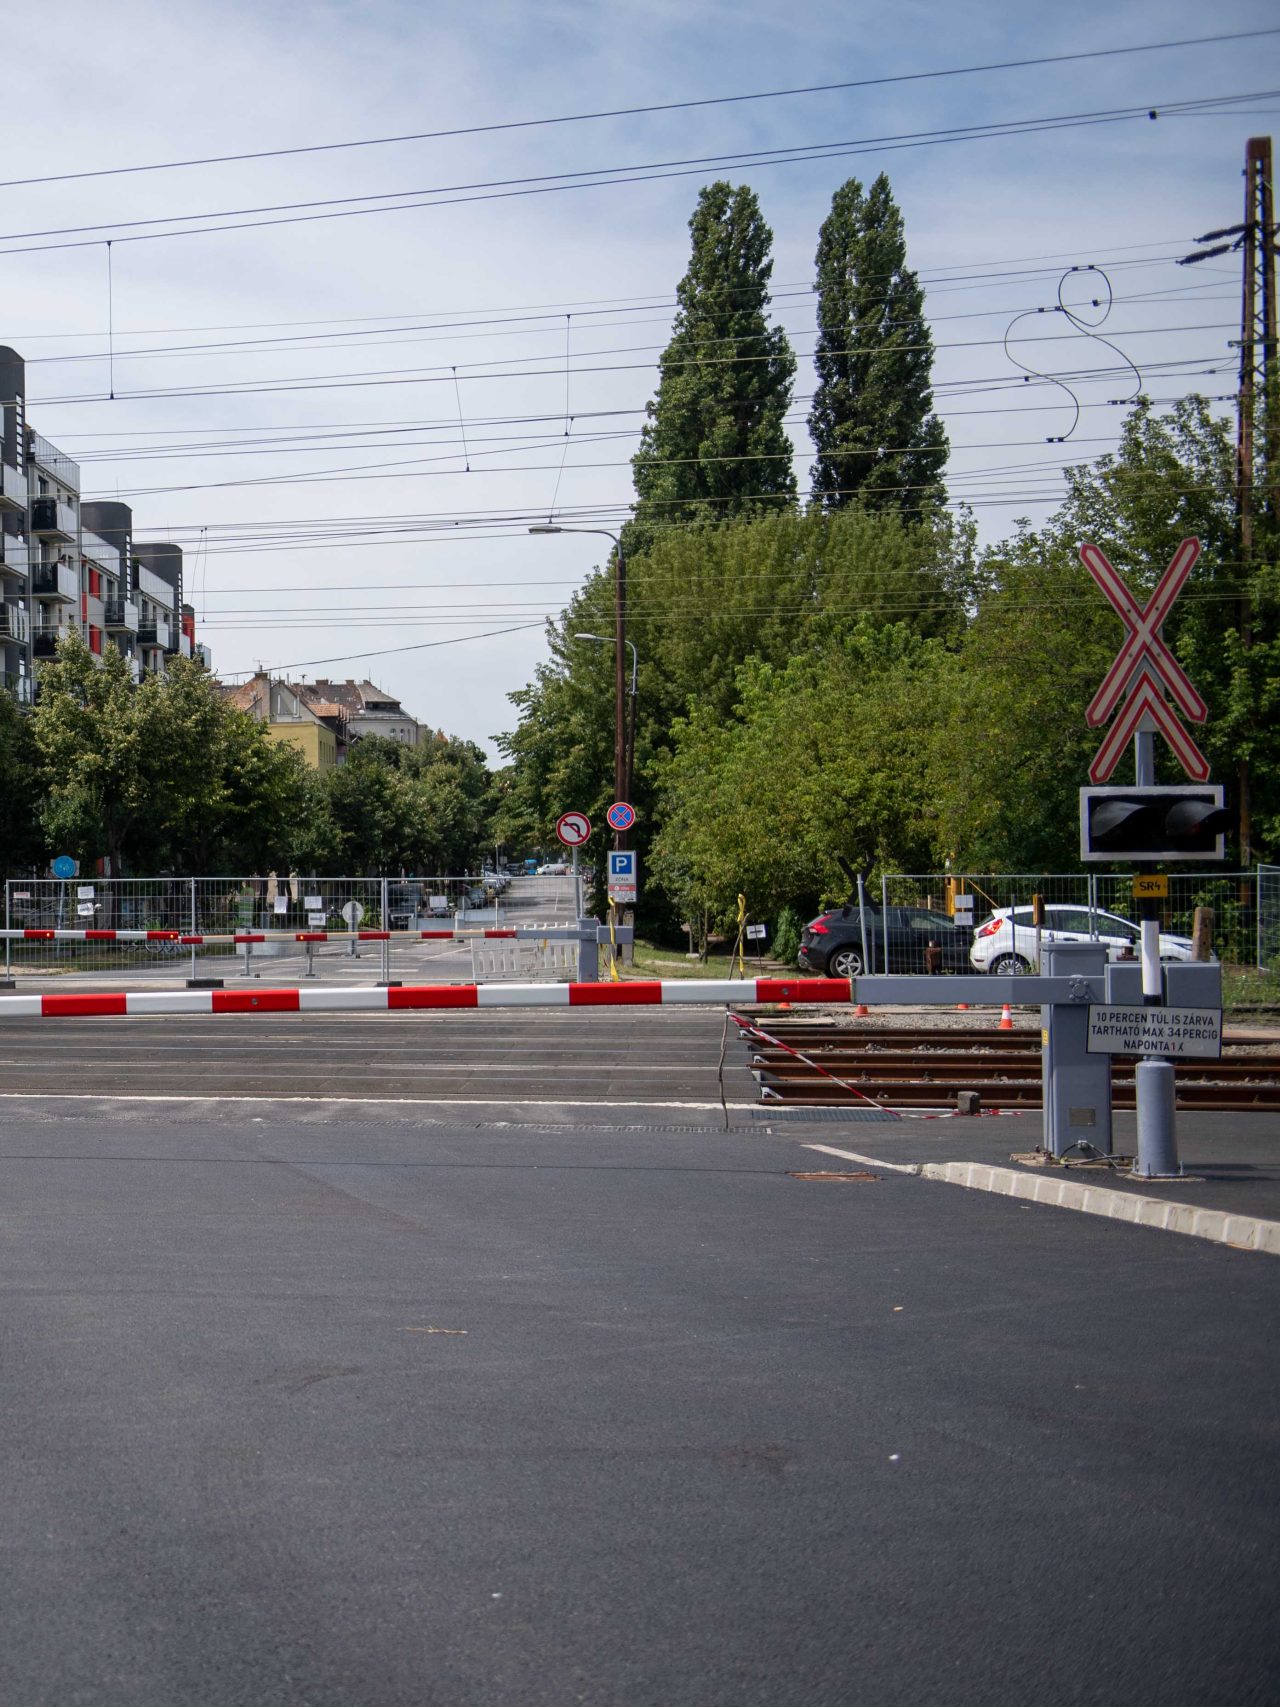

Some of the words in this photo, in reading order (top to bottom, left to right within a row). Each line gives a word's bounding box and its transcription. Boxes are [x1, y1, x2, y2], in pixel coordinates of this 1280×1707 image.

[616, 857, 628, 872] P
[1139, 881, 1160, 891] SR4
[1097, 1012, 1107, 1022] 10
[1109, 1012, 1148, 1023] PERCEN
[1150, 1010, 1169, 1024] TÚL
[1171, 1015, 1181, 1025] IS
[1183, 1012, 1214, 1026] ZÁRVA
[1091, 1023, 1140, 1037] TARTHATÓ
[1142, 1026, 1164, 1037] MAX
[1167, 1027, 1181, 1037] 34
[1182, 1028, 1218, 1040] PERCIG
[1123, 1039, 1170, 1051] NAPONTA
[1171, 1042, 1176, 1051] 1
[1178, 1042, 1184, 1052] X
